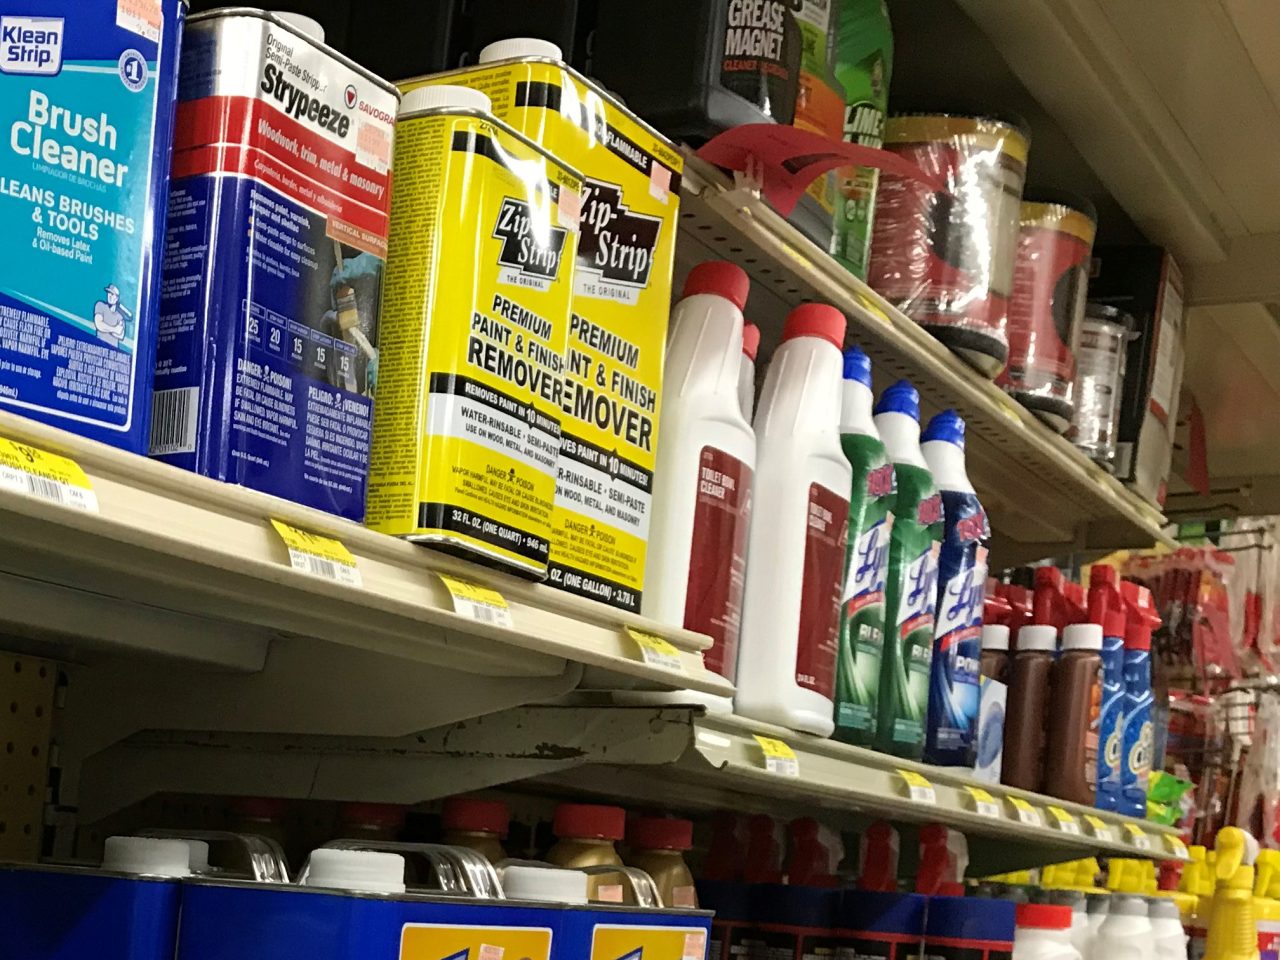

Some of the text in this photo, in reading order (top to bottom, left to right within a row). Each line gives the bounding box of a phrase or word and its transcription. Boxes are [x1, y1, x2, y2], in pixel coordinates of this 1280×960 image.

[3, 26, 58, 44] Klean
[728, 0, 785, 34] GREASE
[7, 45, 50, 67] Strip
[267, 33, 293, 55] Original
[725, 29, 783, 61] MAGNET
[28, 89, 117, 150] Brush
[261, 63, 350, 138] Strypeeze
[10, 121, 128, 187] Cleaner
[258, 119, 384, 200] Woodwork, trim, metal & masonry
[32, 207, 99, 240] & TOOLS
[60, 195, 135, 234] BRUSHES
[37, 227, 90, 251] Removes Latex
[518, 237, 559, 274] Strip
[596, 231, 648, 280] Strip
[507, 275, 544, 288] THE ORIGINAL
[472, 313, 511, 346] PAINT
[515, 336, 523, 353] &
[493, 294, 552, 337] PREMIUM
[570, 314, 639, 369] PREMIUM
[468, 336, 563, 406] REMOVER
[700, 480, 725, 499] CLEANER
[702, 467, 735, 490] TOILET BOWL
[452, 510, 462, 521] 32
[472, 517, 482, 530] OZ.
[483, 521, 498, 536] (ONE
[499, 526, 522, 545] QUART)
[527, 536, 538, 550] 946
[539, 541, 548, 552] mL
